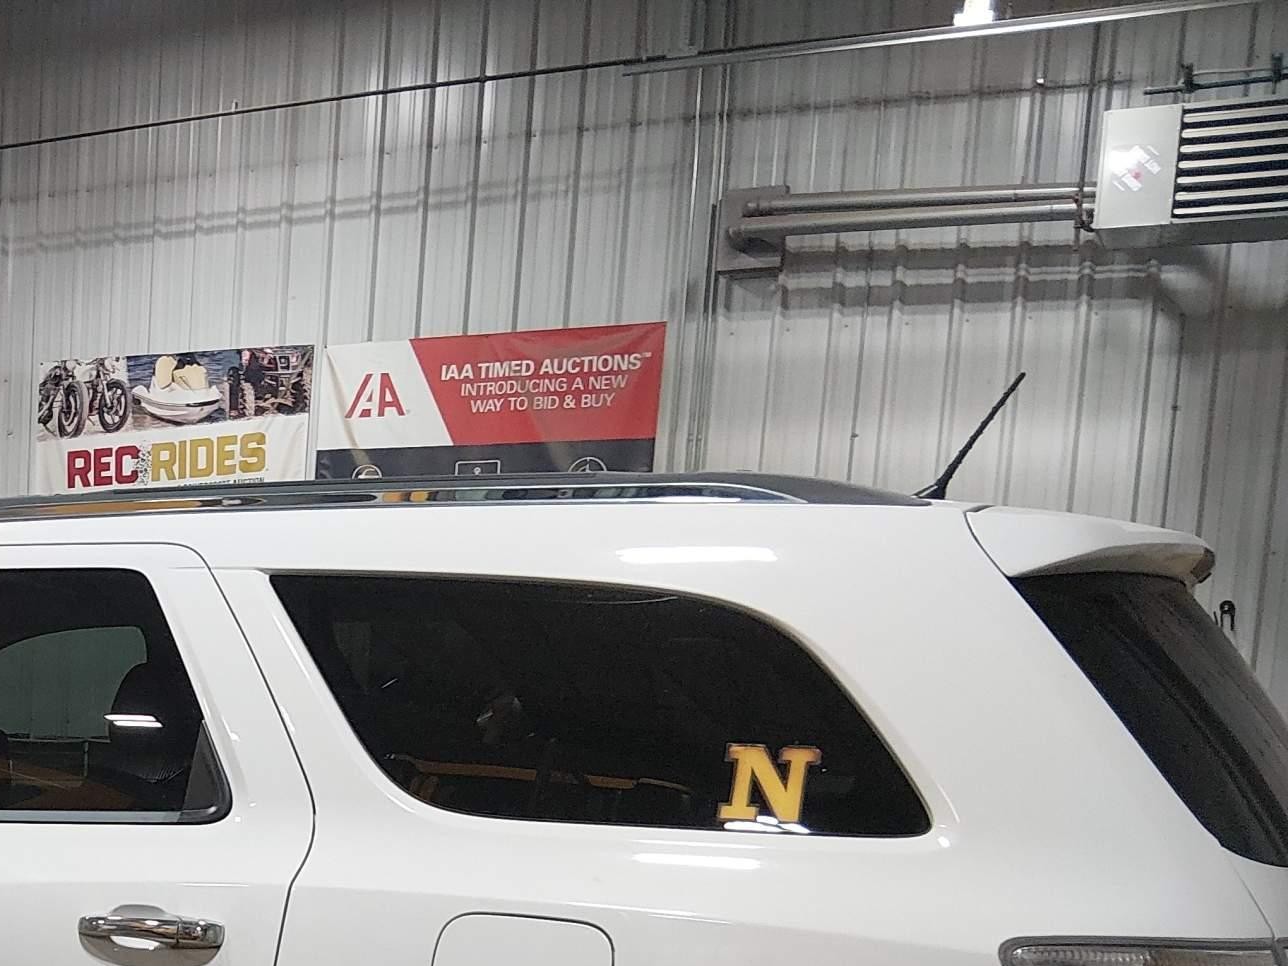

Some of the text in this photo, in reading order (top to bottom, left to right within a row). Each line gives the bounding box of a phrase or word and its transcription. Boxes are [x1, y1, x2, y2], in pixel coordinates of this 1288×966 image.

[441, 364, 474, 380] IAA
[478, 360, 535, 378] TIMED
[461, 374, 629, 397] INTRODUCING A NEW
[470, 392, 616, 413] WAY TO BID & BUY
[67, 432, 267, 489] REC RIDES
[716, 743, 822, 823] N
